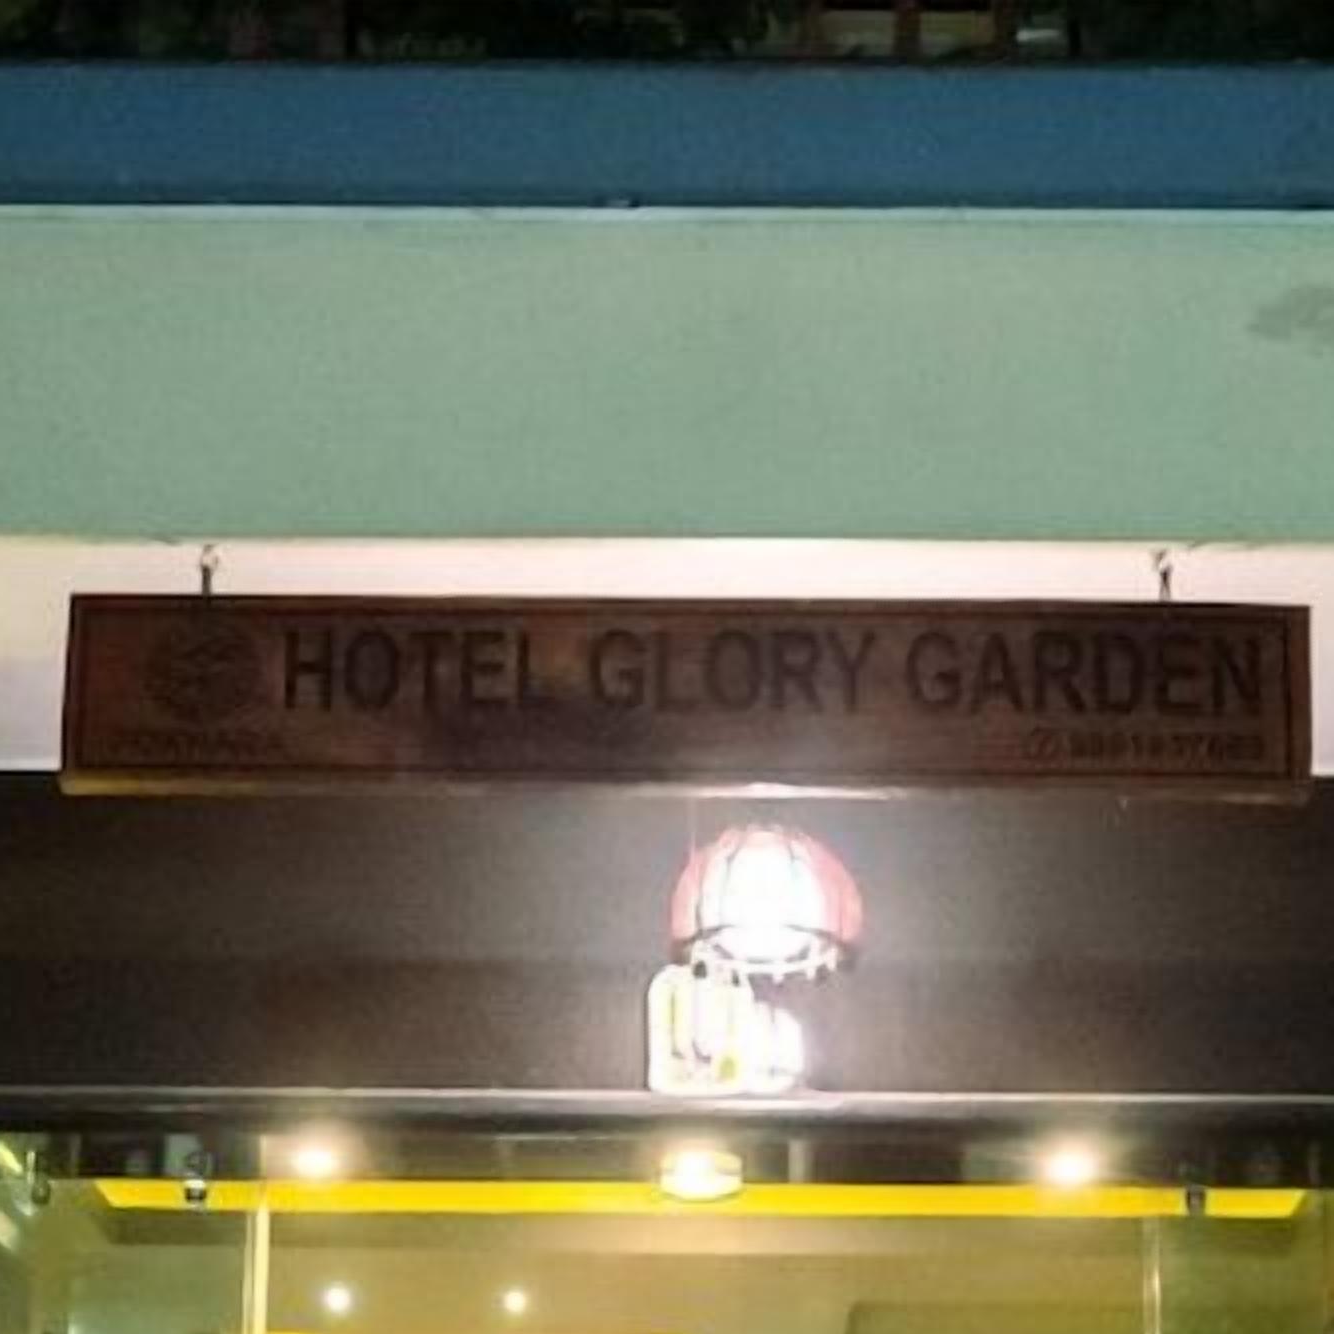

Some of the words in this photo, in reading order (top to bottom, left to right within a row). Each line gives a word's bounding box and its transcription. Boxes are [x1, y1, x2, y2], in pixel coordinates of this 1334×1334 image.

[283, 630, 549, 712] HOTEL
[588, 629, 875, 712] GLORY
[905, 630, 1264, 715] GARDEN
